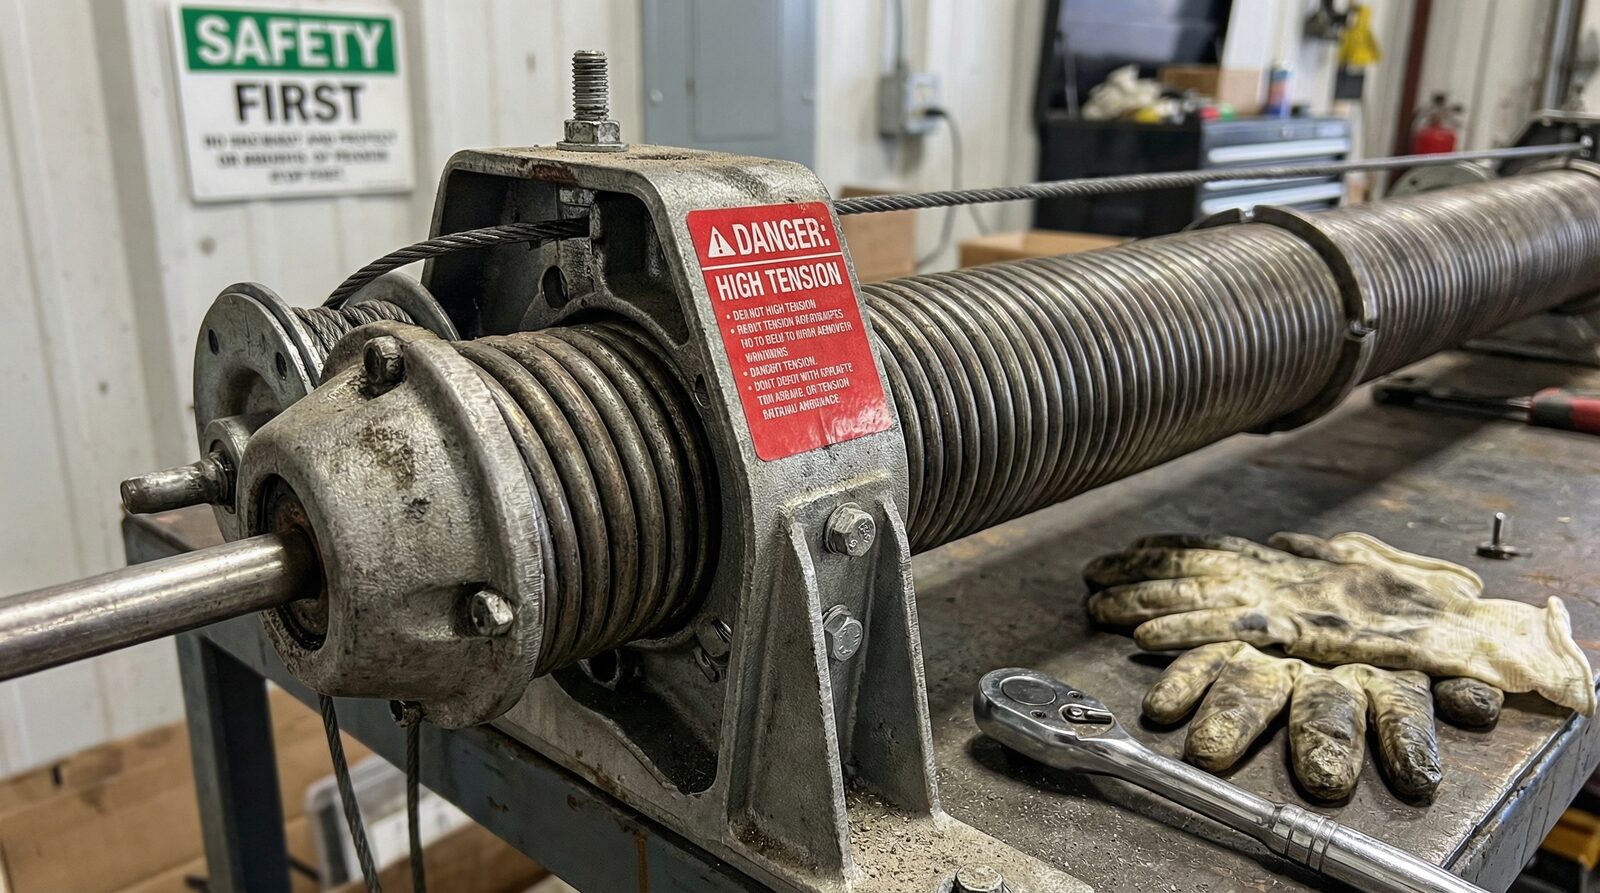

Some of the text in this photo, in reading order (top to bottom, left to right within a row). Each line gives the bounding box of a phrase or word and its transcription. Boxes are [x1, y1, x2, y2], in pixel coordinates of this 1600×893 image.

[196, 14, 385, 68] SAFETY
[234, 83, 365, 124] FIRST
[732, 217, 831, 256] DANGER:
[715, 261, 843, 301] HIGH TENSION
[765, 303, 784, 316] HIGH
[784, 299, 817, 312] TENSION
[763, 315, 795, 330] TENSION
[754, 336, 765, 346] TO
[784, 331, 796, 341] TO
[800, 370, 820, 382] WITH
[816, 377, 850, 392] TENSION
